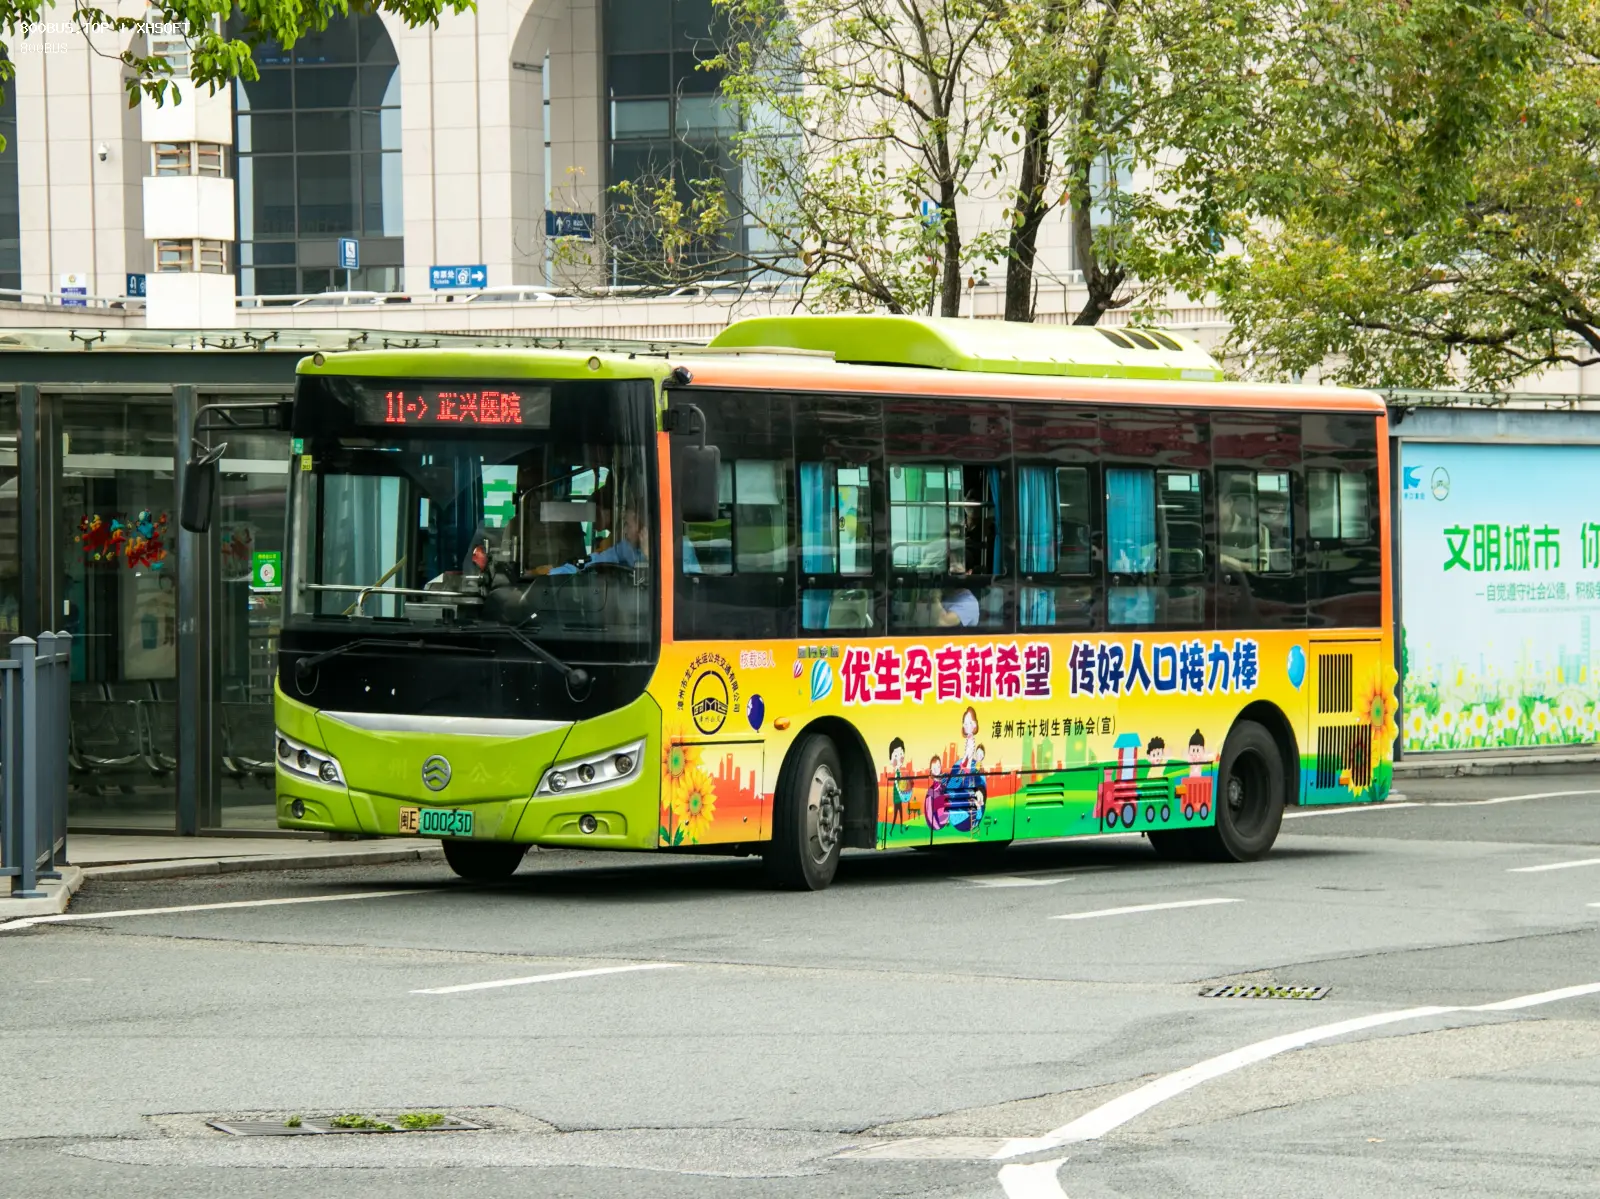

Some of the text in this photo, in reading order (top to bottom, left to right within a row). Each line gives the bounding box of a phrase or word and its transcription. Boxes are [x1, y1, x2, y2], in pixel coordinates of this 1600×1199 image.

[436, 391, 522, 424] 正兴医院
[1443, 524, 1560, 572] 文明城市
[840, 638, 1261, 706] 优生孕育新希望 传好人口接力棒
[991, 716, 1116, 739] 漳州市计划生育协会(宣)
